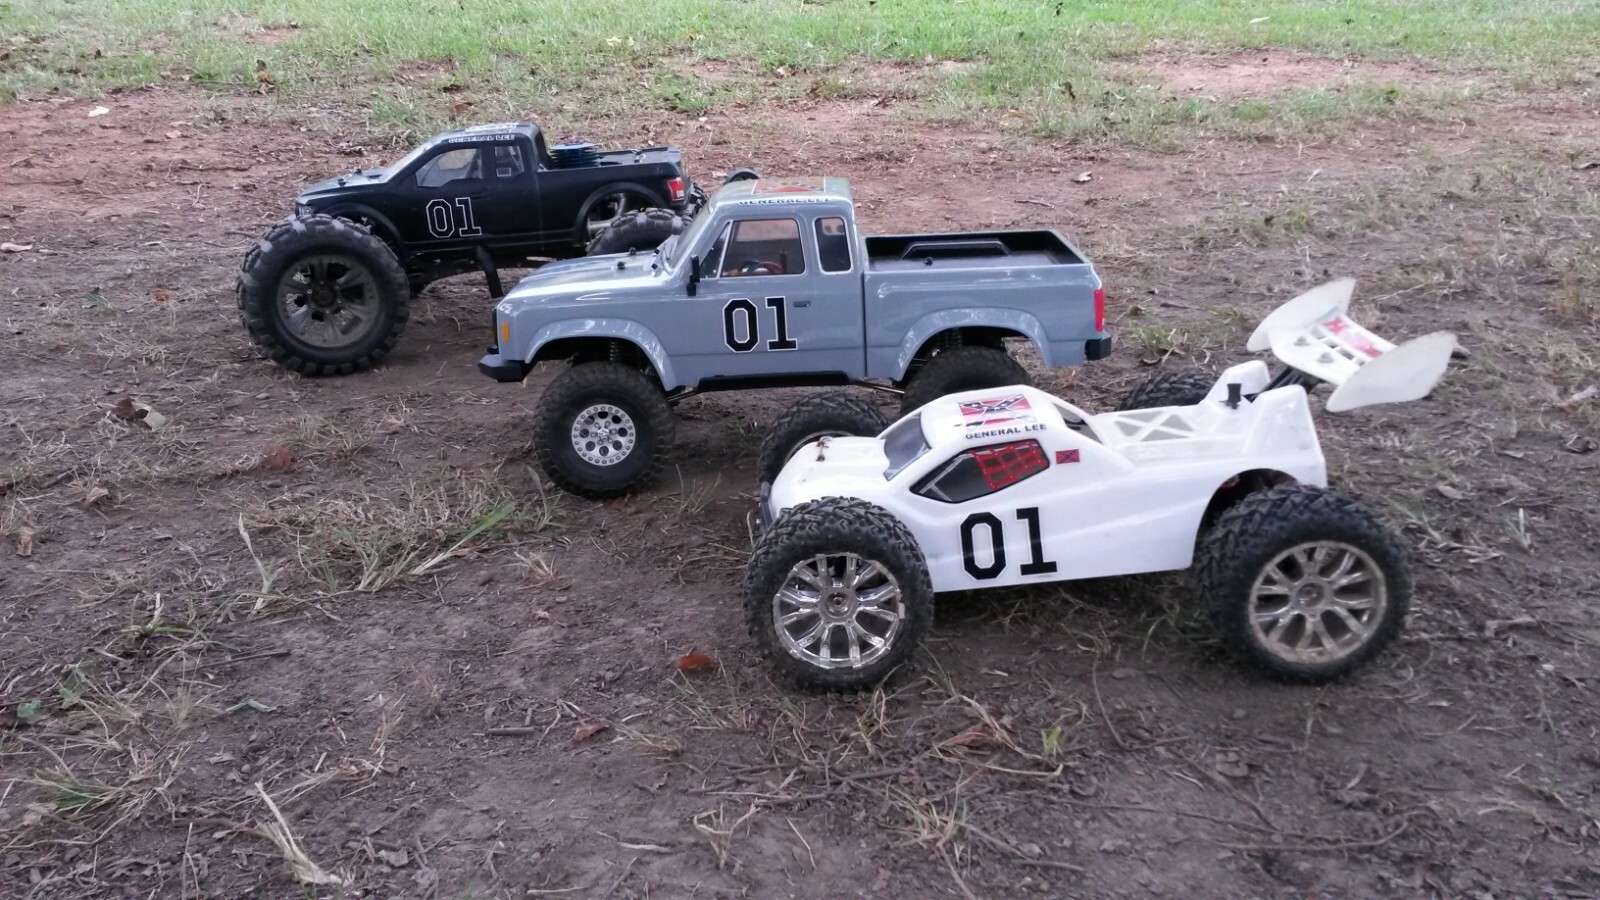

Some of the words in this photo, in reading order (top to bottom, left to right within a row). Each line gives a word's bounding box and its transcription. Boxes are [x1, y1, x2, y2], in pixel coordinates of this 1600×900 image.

[426, 197, 482, 238] 01
[723, 296, 798, 353] 01
[965, 427, 1021, 440] GENERAL
[1025, 423, 1047, 432] LEE
[960, 506, 1058, 580] 01
